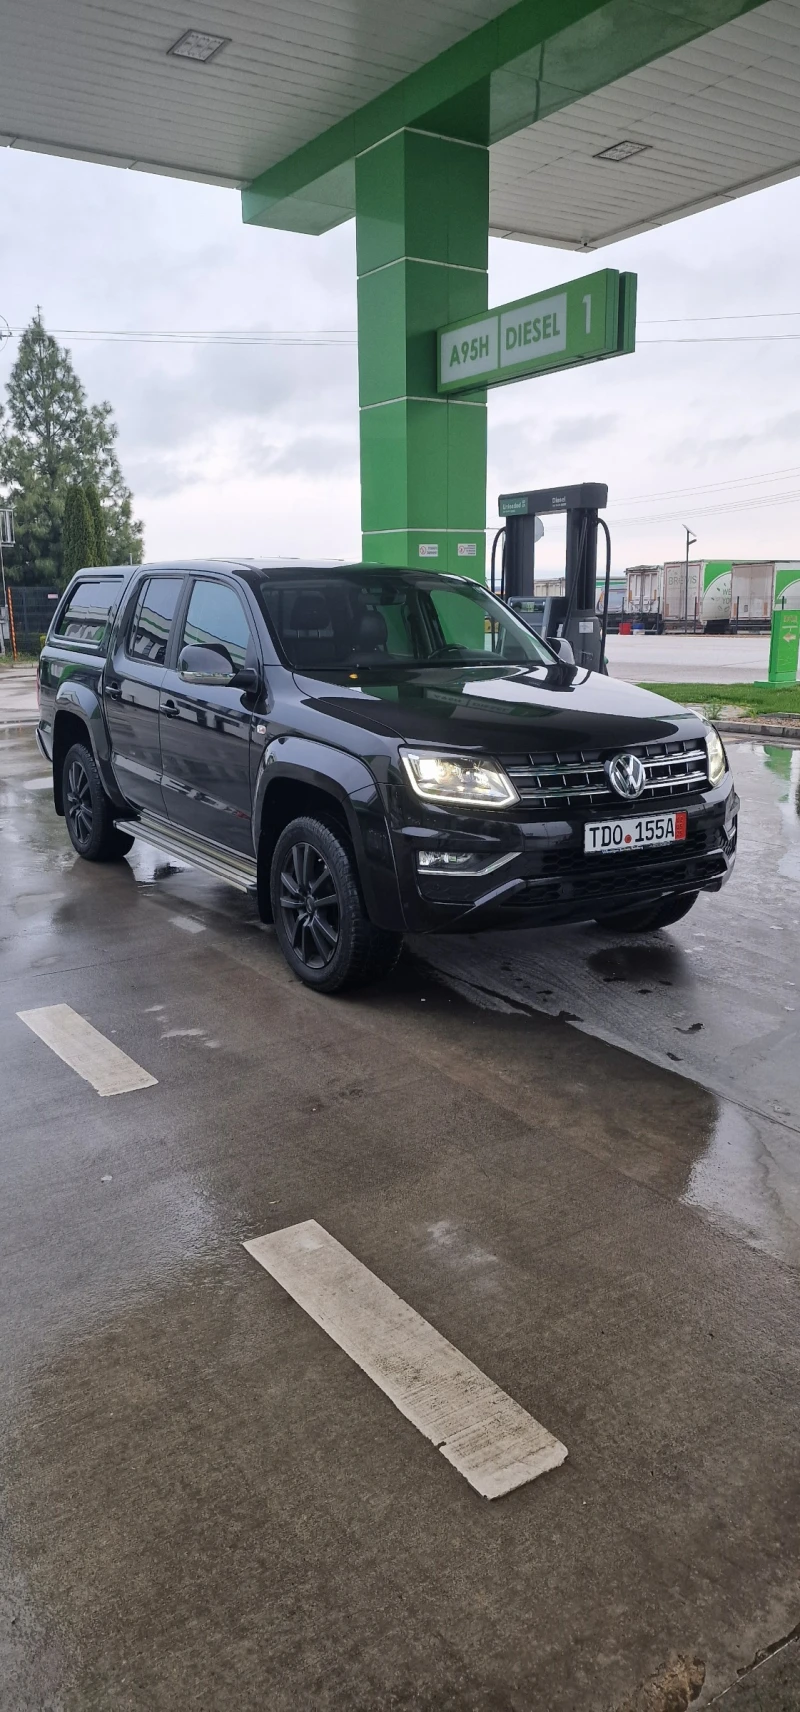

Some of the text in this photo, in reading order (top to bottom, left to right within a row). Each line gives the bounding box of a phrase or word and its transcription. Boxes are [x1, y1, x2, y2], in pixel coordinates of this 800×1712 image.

[449, 294, 592, 368] A95H DIESEL 1
[589, 824, 623, 848] TDO
[634, 818, 675, 843] 155A
